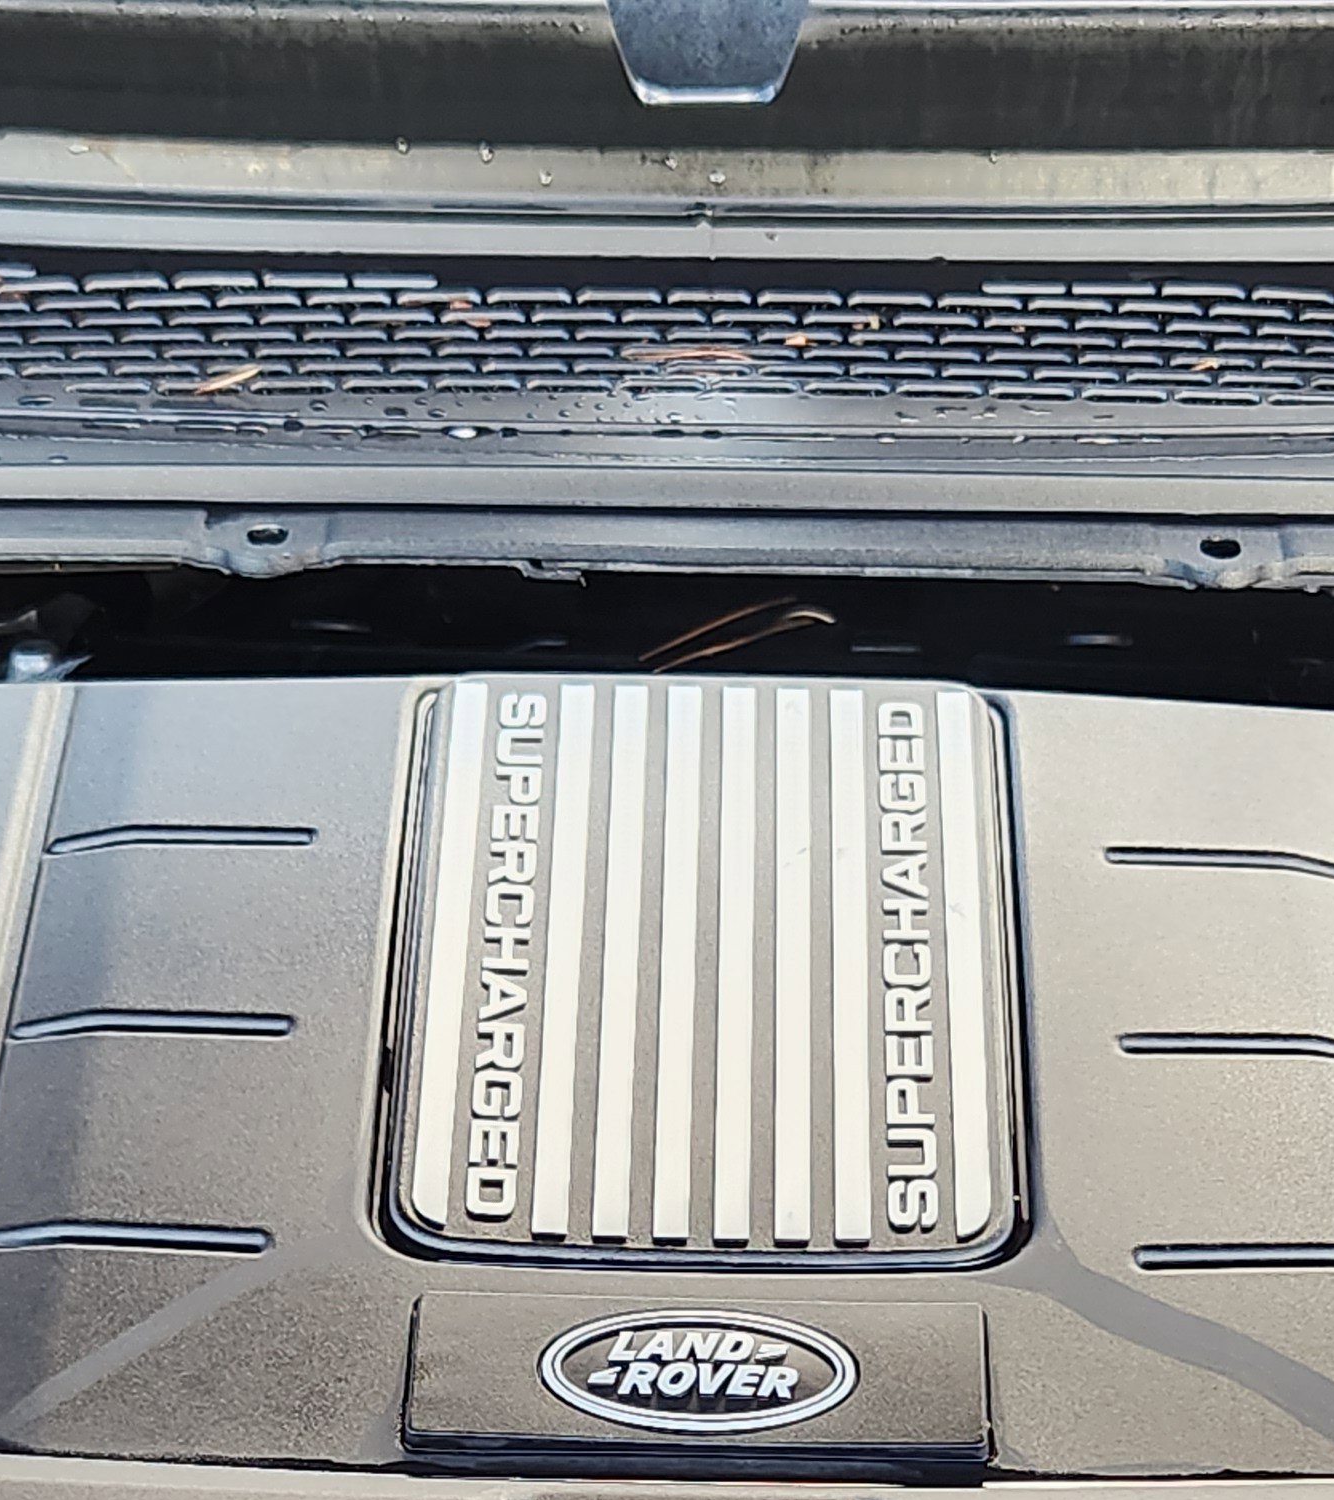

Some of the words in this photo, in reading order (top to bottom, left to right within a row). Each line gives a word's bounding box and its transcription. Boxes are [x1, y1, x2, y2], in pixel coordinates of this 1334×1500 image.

[466, 692, 547, 1221] SUPERCHARGED
[877, 701, 939, 1233] SUPERCHARGED
[607, 1330, 754, 1362] LAND
[617, 1362, 800, 1400] ROVER
